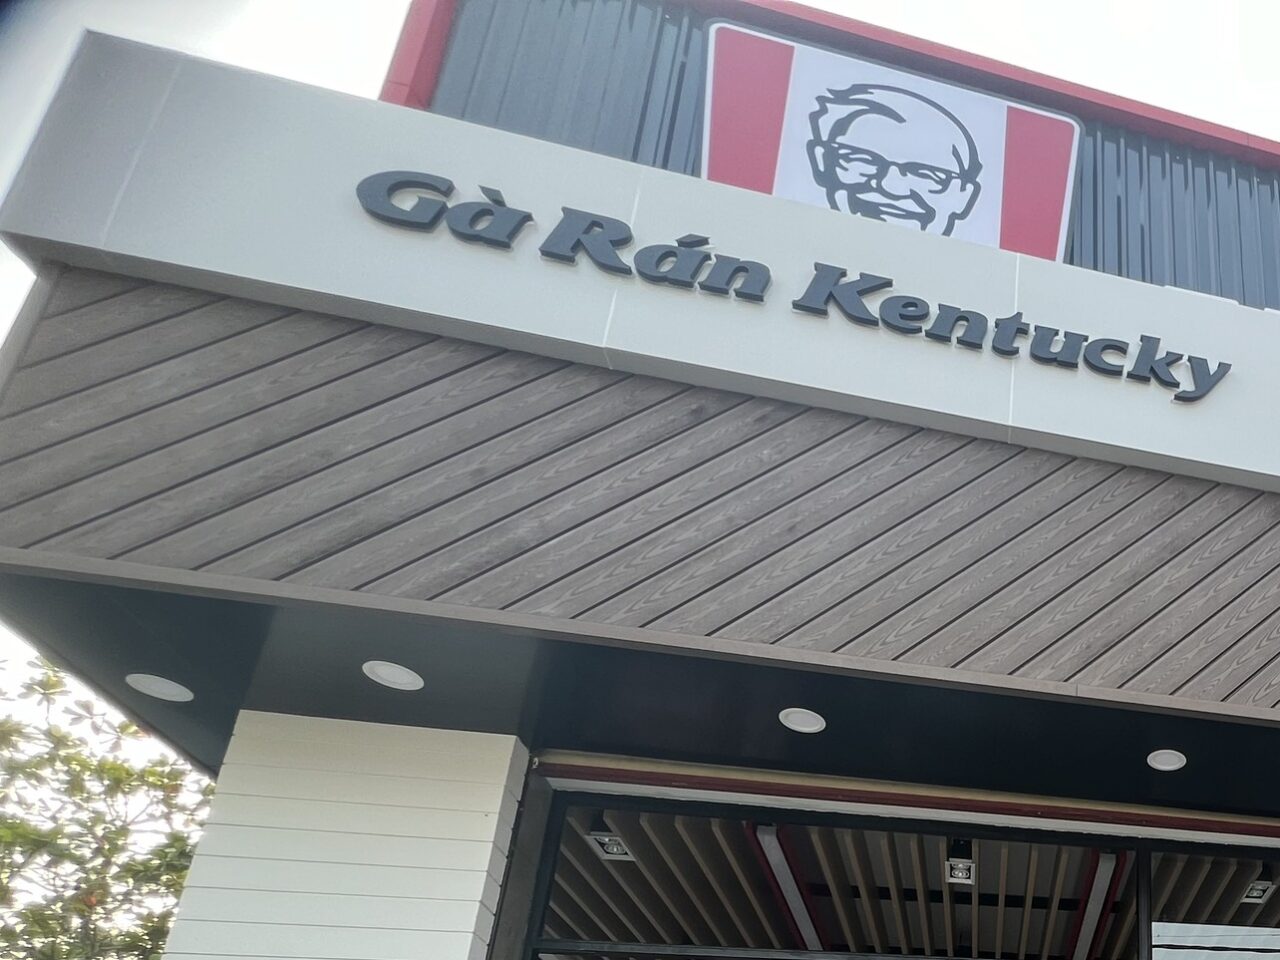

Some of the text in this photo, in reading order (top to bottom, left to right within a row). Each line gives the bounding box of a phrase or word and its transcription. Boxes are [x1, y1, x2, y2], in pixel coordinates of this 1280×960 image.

[355, 169, 1233, 403] Gà Rán Kentucky
